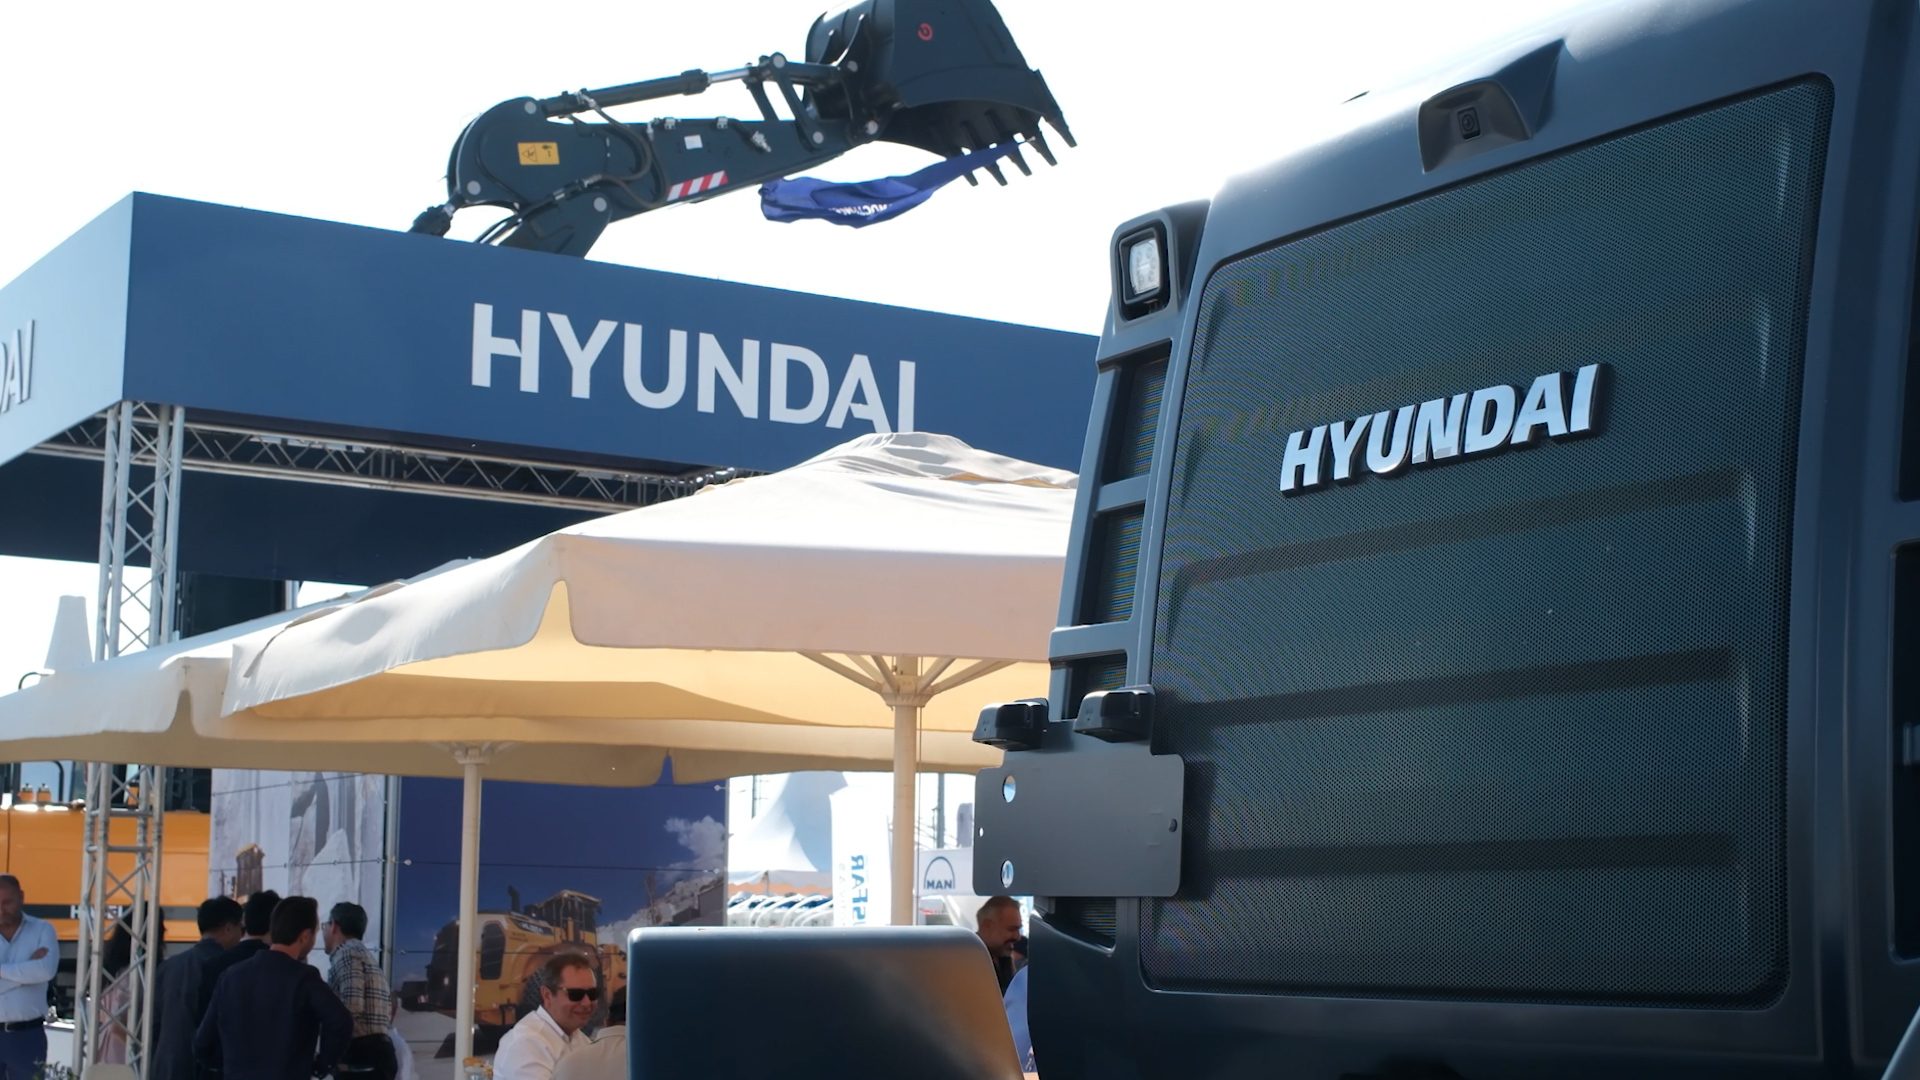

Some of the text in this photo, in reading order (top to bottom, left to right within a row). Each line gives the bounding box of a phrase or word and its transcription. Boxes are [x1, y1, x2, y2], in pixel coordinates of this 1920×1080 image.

[471, 302, 916, 433] HYUNDAI
[1279, 363, 1600, 492] HYUNDAI
[926, 879, 953, 890] MAN
